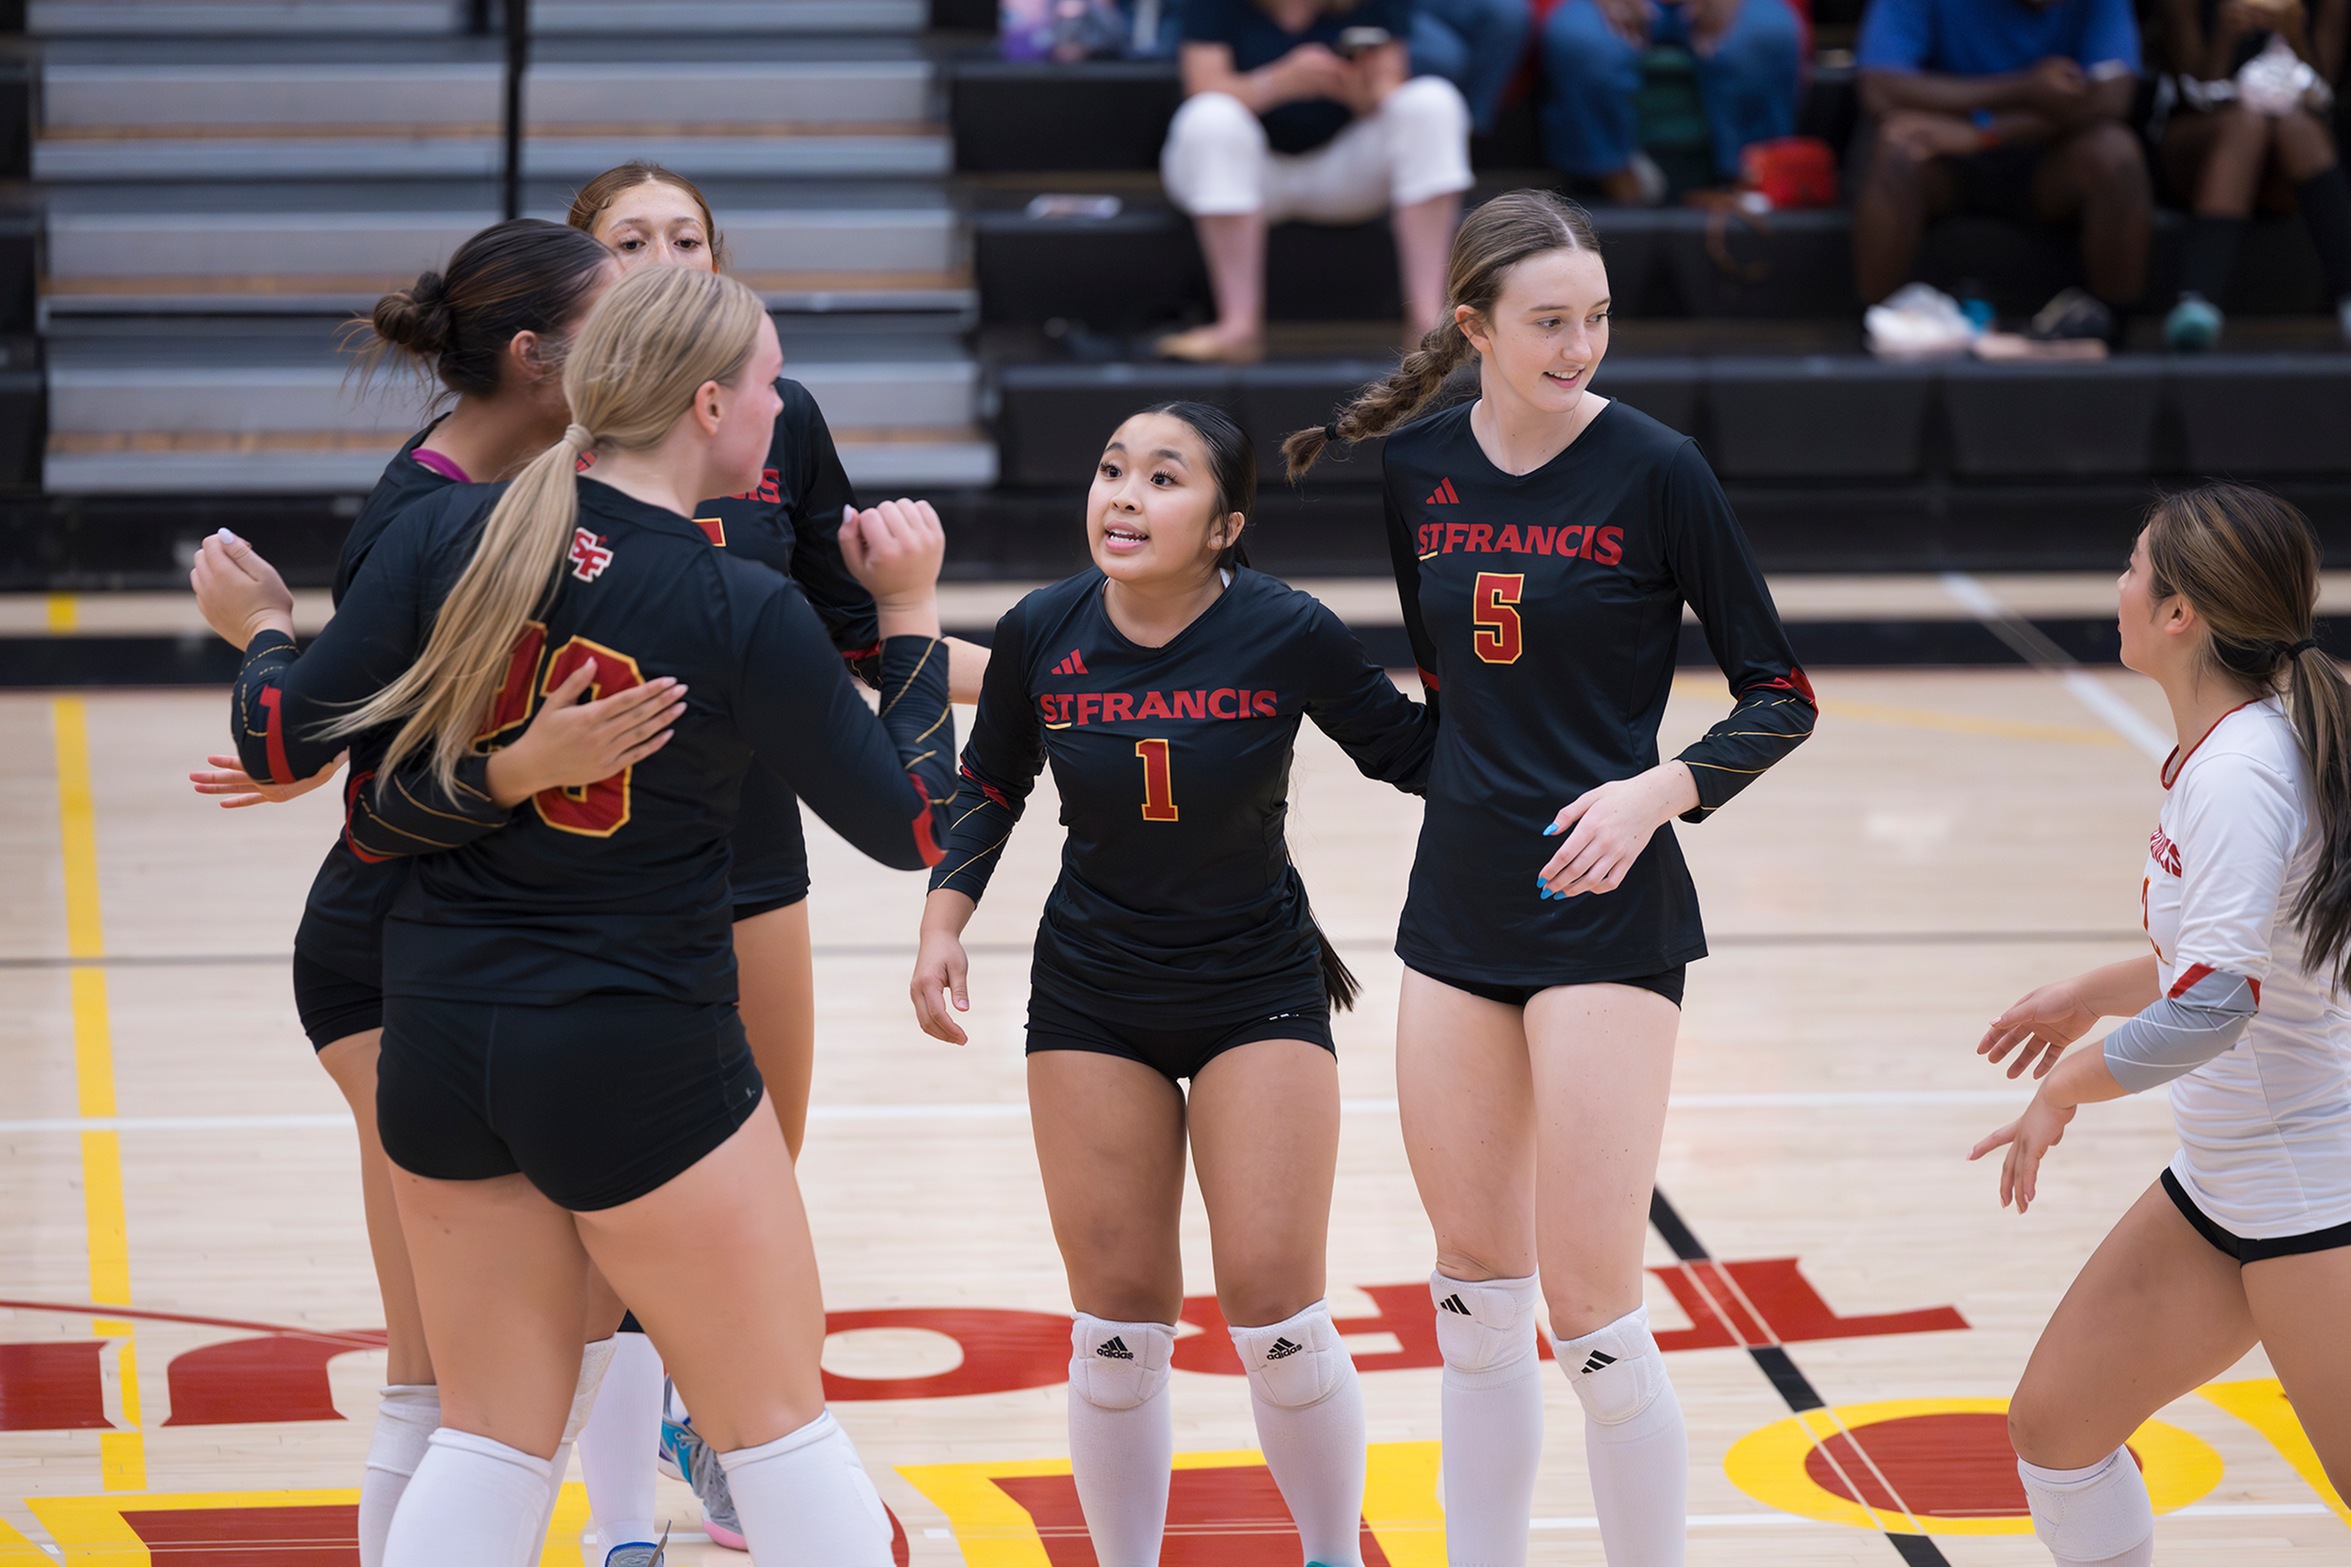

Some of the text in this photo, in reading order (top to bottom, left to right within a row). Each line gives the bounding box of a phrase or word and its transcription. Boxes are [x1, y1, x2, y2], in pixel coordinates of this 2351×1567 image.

[1473, 572, 1525, 664] 5
[1135, 738, 1179, 822] 1
[1096, 1347, 1134, 1360] adidas
[1266, 1343, 1303, 1361] adidas
